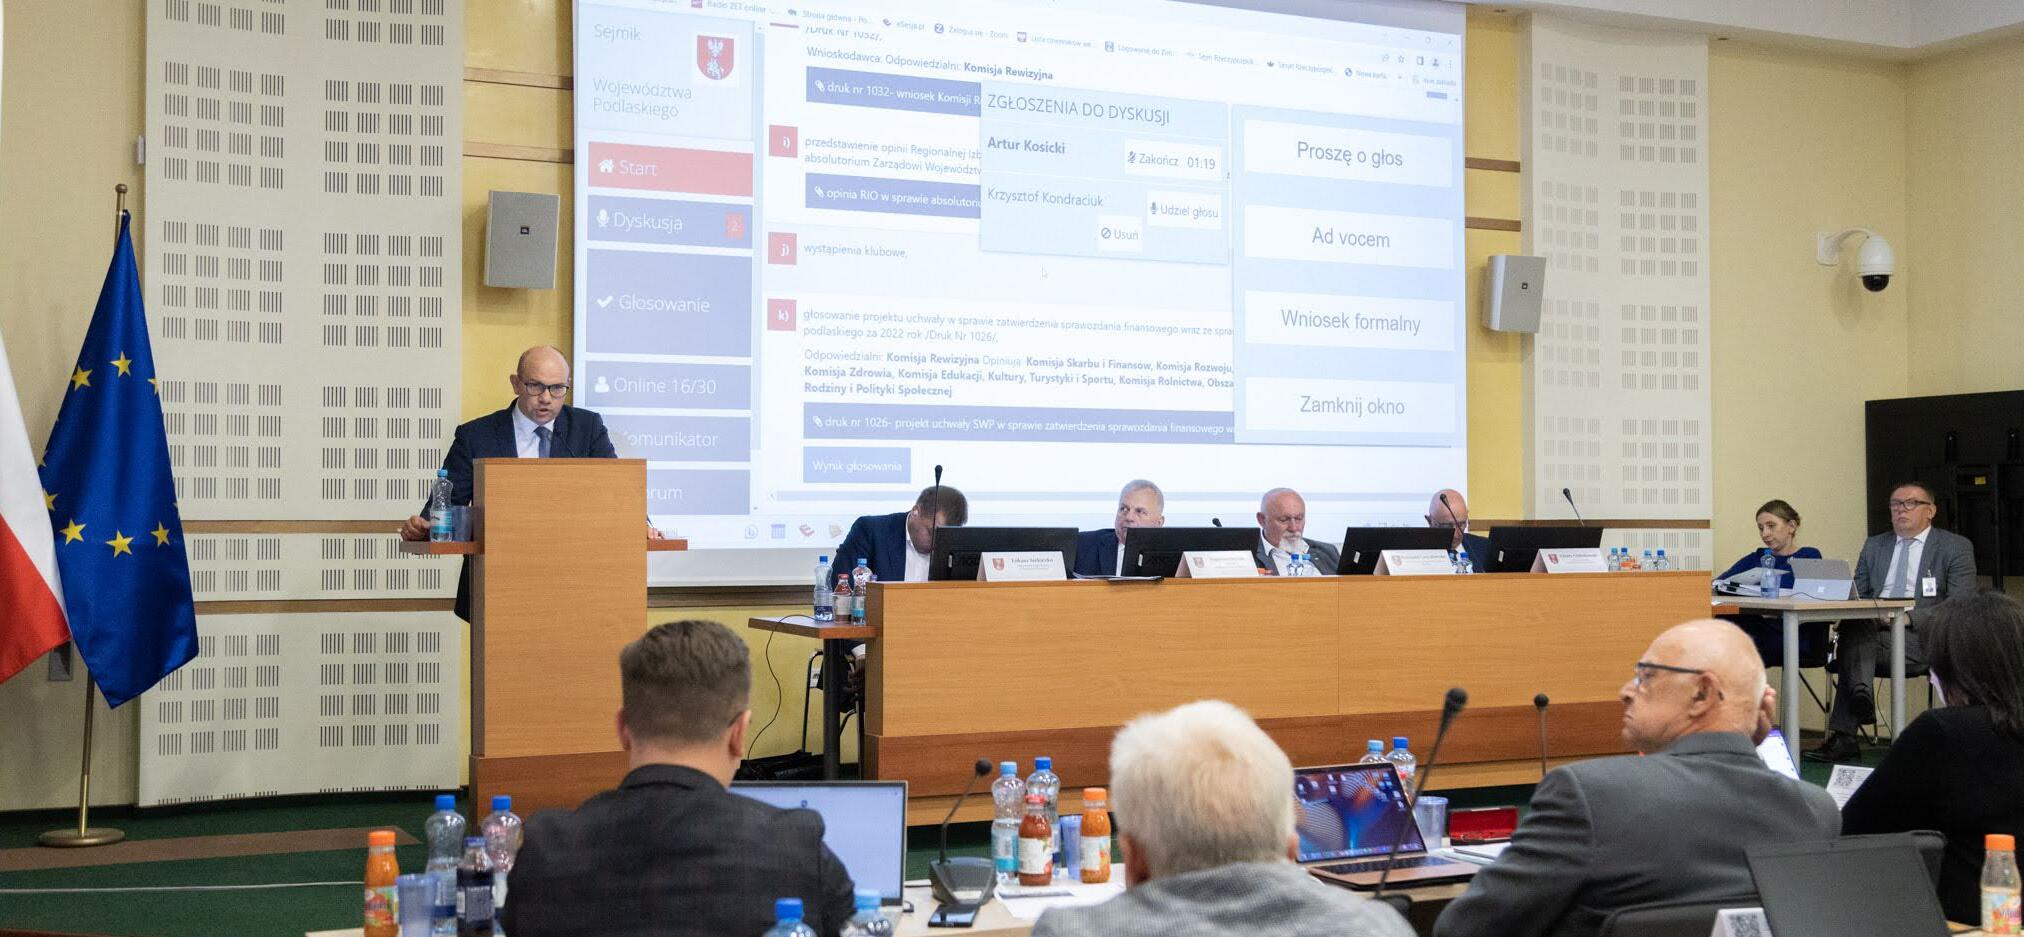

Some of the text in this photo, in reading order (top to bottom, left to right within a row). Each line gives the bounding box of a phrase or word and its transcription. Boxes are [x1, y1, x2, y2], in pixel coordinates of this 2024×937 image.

[593, 23, 641, 42] Sejmik
[964, 62, 1002, 76] Komisja
[1006, 66, 1053, 80] Rewizyjna
[593, 77, 692, 100] Województwa
[828, 81, 850, 93] druk
[867, 86, 893, 97] 1032-
[896, 89, 935, 102] wniosek
[938, 91, 972, 106] Komisji
[593, 97, 679, 120] Podlaskiego
[987, 94, 1170, 126] ZGŁOSZENIA DO DYSKUSJI
[805, 138, 879, 152] przedstawienie
[881, 143, 907, 154] opinii
[911, 145, 966, 161] Regionalnej
[987, 137, 1065, 154] Artur Kosicki
[805, 153, 870, 167] absolutorium
[873, 157, 922, 171] Zarządowi
[1139, 152, 1216, 170] Zakończ 01:19
[1297, 141, 1403, 169] Proszę o głos
[619, 159, 657, 176] Start
[827, 190, 857, 202] opinia
[860, 190, 878, 201] RIO
[881, 193, 889, 201] w
[892, 192, 928, 206] sprawie
[987, 187, 1104, 207] Krzysztof Kondraciuk
[1160, 203, 1218, 219] Udziel głosu
[614, 211, 683, 234] Dyskusja
[730, 220, 740, 231] 2
[1114, 228, 1138, 240] Usuń
[1312, 226, 1390, 248] Ad vocem
[803, 243, 862, 257] wystąpienia
[619, 294, 710, 313] Głosowanie
[778, 309, 789, 322] k)
[803, 309, 860, 322] głosowanie
[863, 312, 903, 324] projektu
[906, 314, 945, 326] uchwały
[958, 316, 994, 328] sprawie
[996, 318, 1059, 329] zatwierdzenia
[1061, 320, 1121, 332] sprawozdania
[1124, 321, 1179, 335] finansowego
[1181, 326, 1200, 334] wraz
[1203, 327, 1212, 335] ze
[1282, 309, 1421, 336] Wniosek formalny
[803, 326, 863, 339] podlaskiego
[866, 330, 877, 338] za
[880, 328, 904, 339] 2022
[907, 329, 921, 340] rok
[924, 330, 951, 341] /Druk
[955, 331, 967, 341] Nr
[886, 352, 927, 365] Komisja
[930, 354, 979, 366] Rewizyjna
[1026, 356, 1064, 369] Komisja
[1067, 358, 1100, 369] Skarbu
[1156, 361, 1192, 374] Komisja
[614, 376, 716, 394] Online 16/30
[804, 366, 846, 379] Komisja
[898, 368, 938, 381] Komisja
[1030, 372, 1074, 385] Turystyki
[1119, 375, 1156, 387] Komisja
[804, 383, 847, 396] Rodziny
[856, 384, 895, 397] Polityki
[898, 385, 953, 398] Społecznej
[1300, 395, 1405, 418] Zamknij okno
[825, 416, 848, 427] druk
[895, 418, 930, 430] projekt
[933, 418, 969, 430] uchwały
[972, 419, 995, 430] SWP
[1007, 420, 1042, 433] sprawie
[1045, 420, 1105, 432] zatwierdzenia
[1108, 422, 1168, 435] sprawozdania
[1170, 423, 1224, 436] finansowego
[626, 431, 718, 447] omunikator
[812, 459, 902, 474] Wynik głosowania
[649, 488, 682, 500] rum
